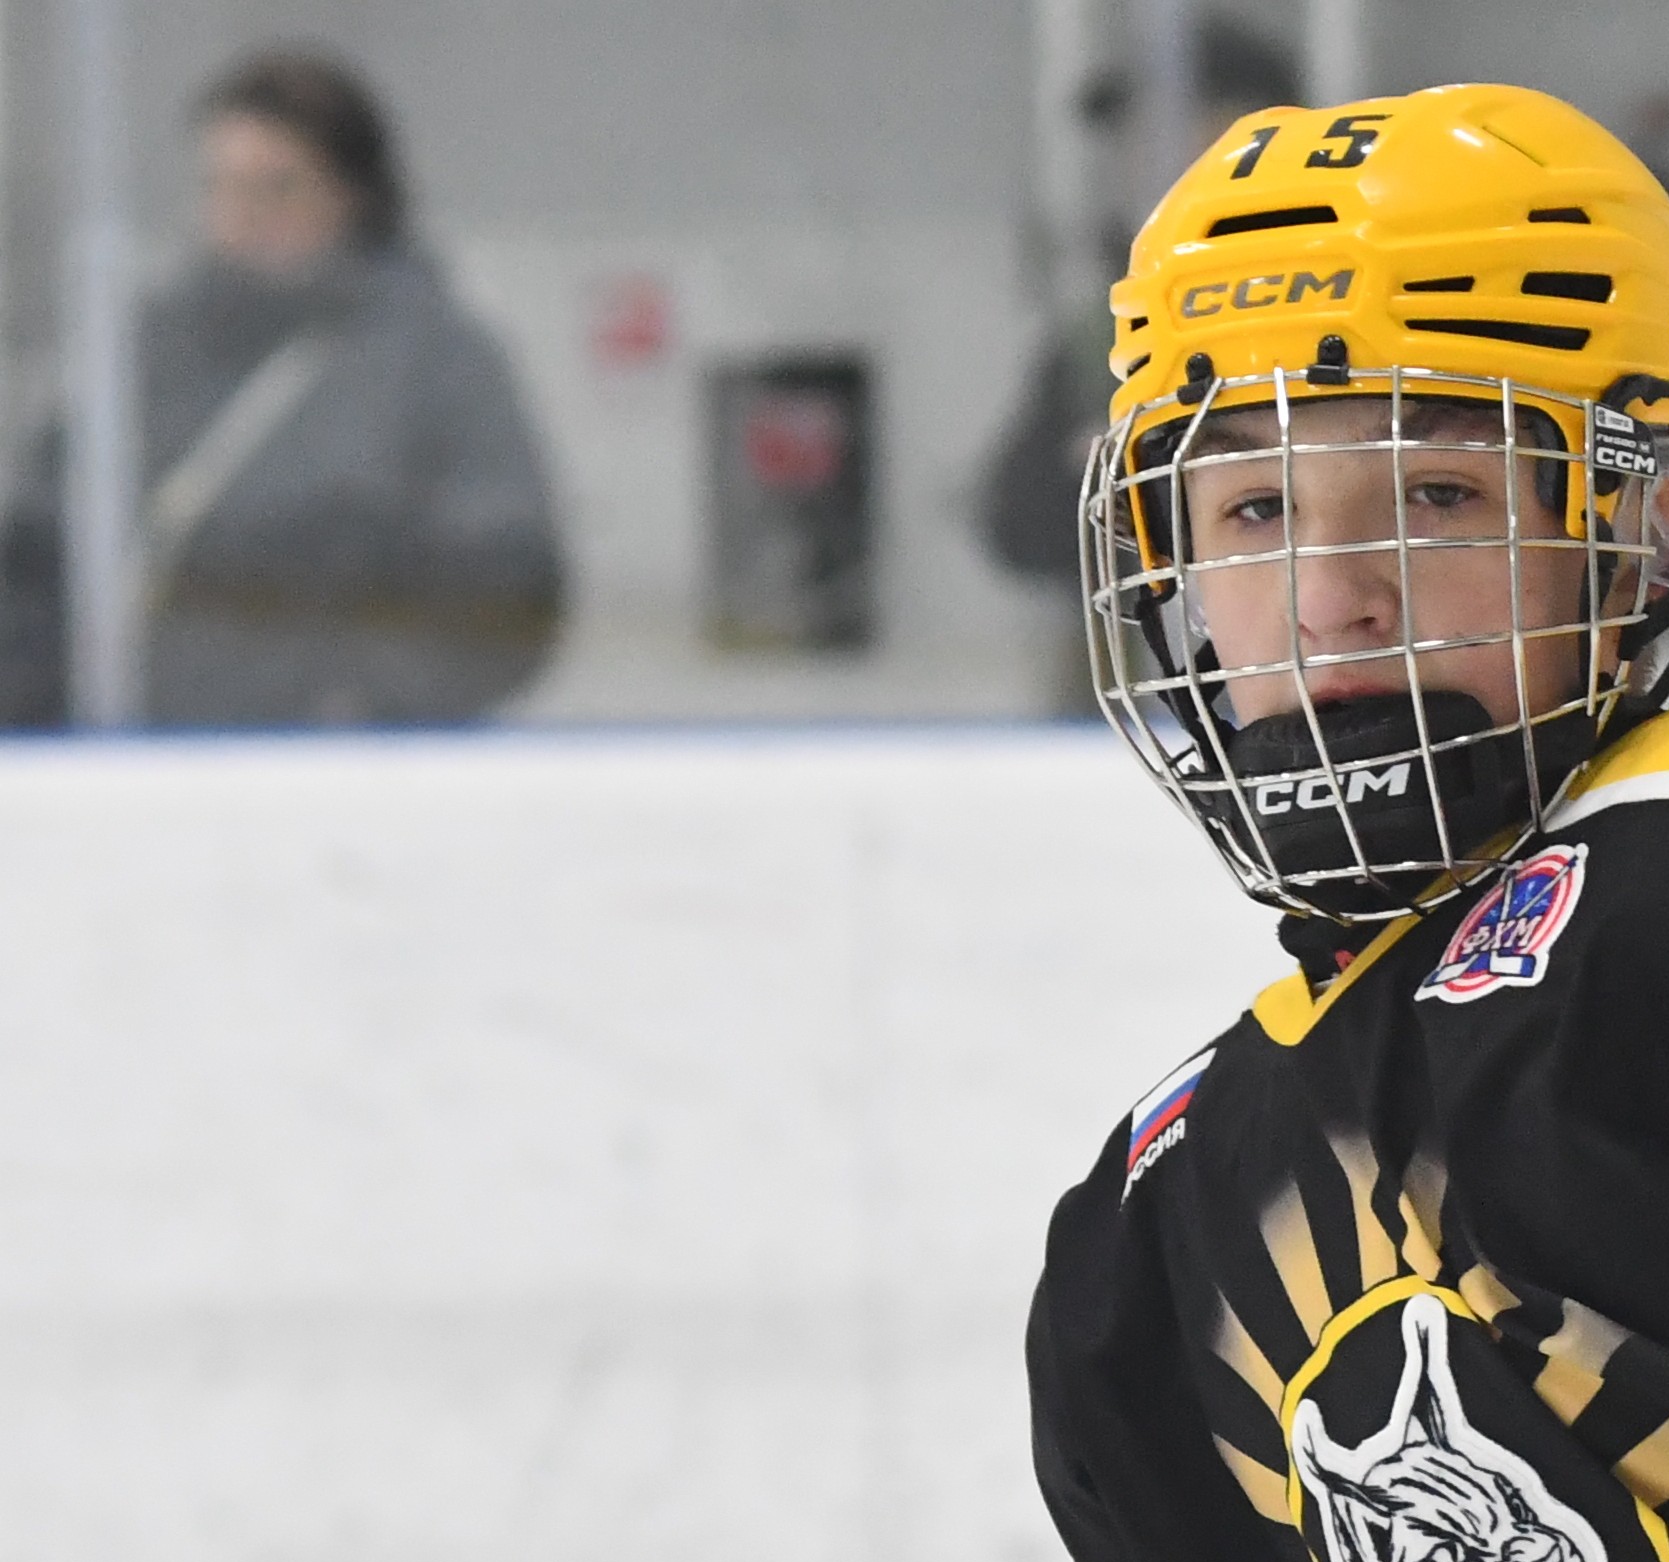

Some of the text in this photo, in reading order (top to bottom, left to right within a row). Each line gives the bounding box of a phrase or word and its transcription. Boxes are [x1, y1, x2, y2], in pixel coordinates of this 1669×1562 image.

[1181, 269, 1356, 319] CCM
[1596, 447, 1656, 474] CCM
[1256, 762, 1411, 815] CCM
[1461, 915, 1544, 955] ФХМ
